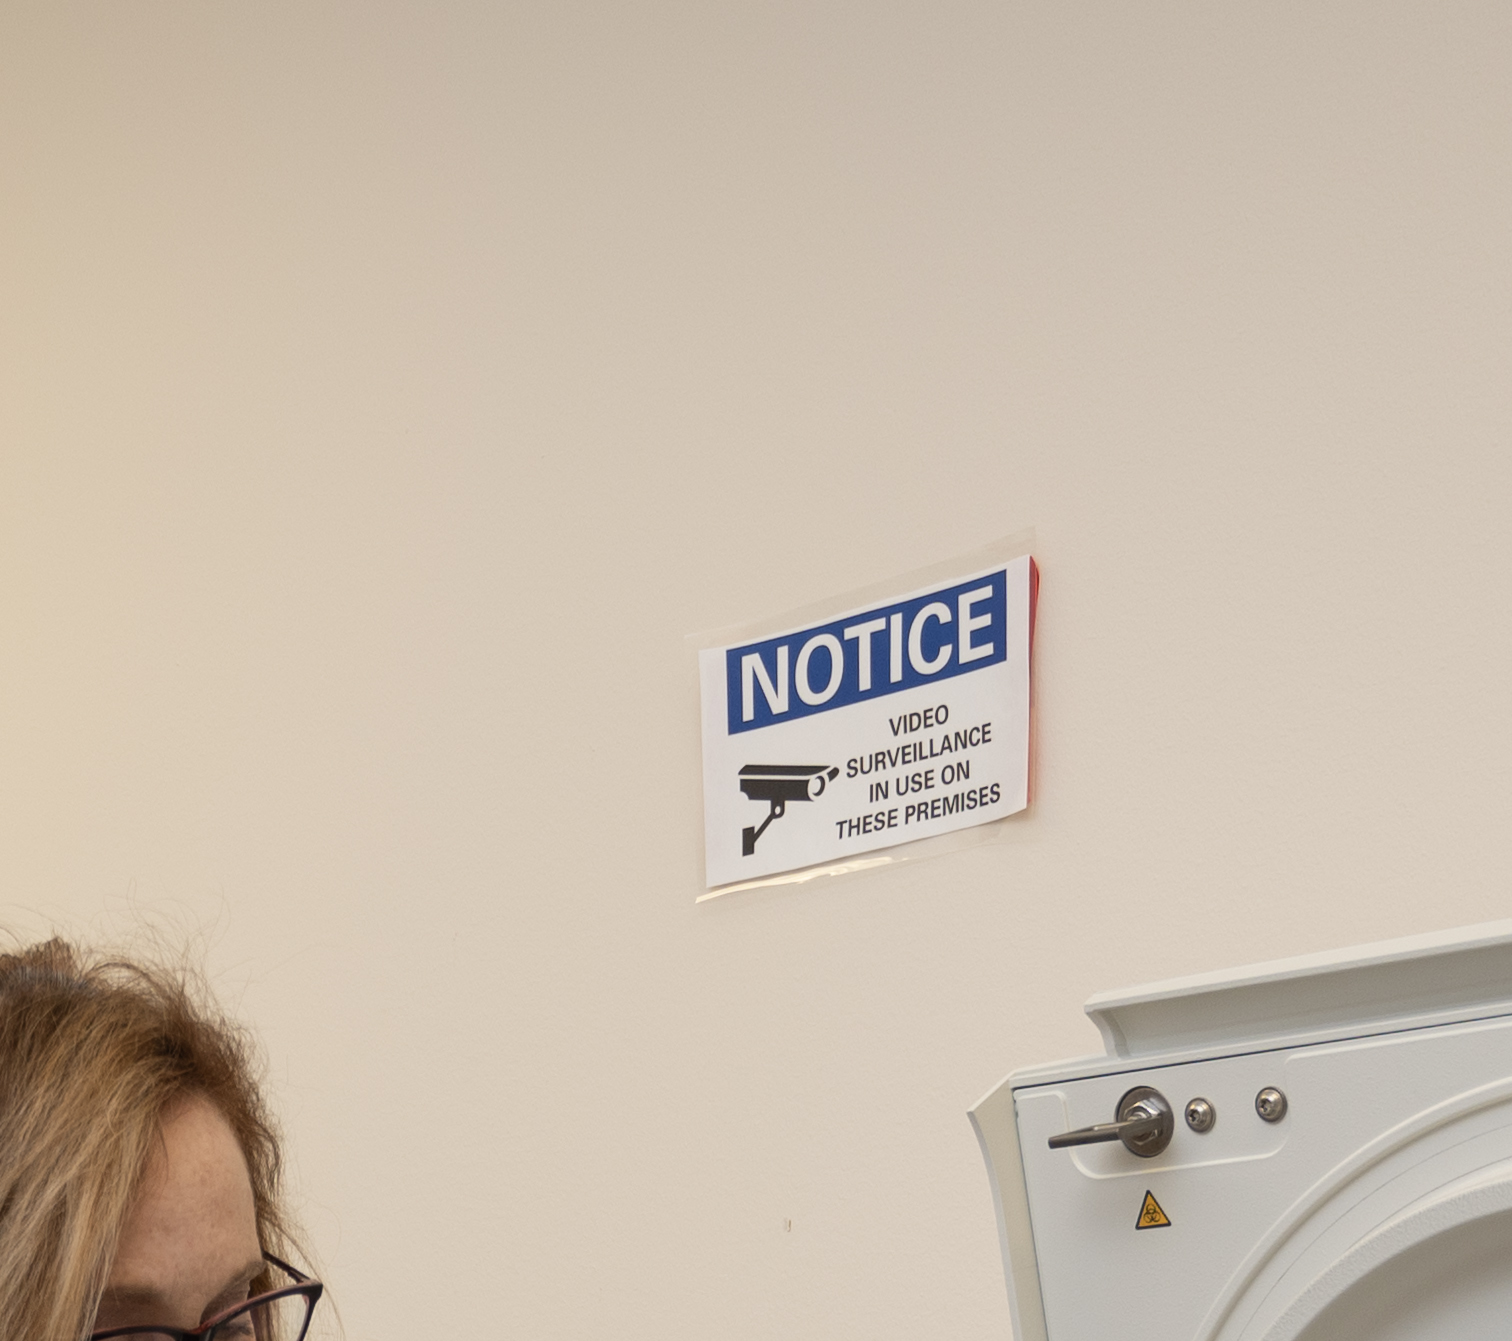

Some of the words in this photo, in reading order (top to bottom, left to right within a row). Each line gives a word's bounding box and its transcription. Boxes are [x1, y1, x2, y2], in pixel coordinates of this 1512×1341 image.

[741, 584, 995, 723] NOTICE
[889, 704, 949, 737] VIDEO
[846, 722, 992, 779] SURVEILLANCE
[869, 779, 889, 803] IN
[895, 769, 935, 798] USE
[941, 760, 970, 788] ON
[835, 808, 898, 840] THESE
[904, 783, 1001, 824] PREMISES
